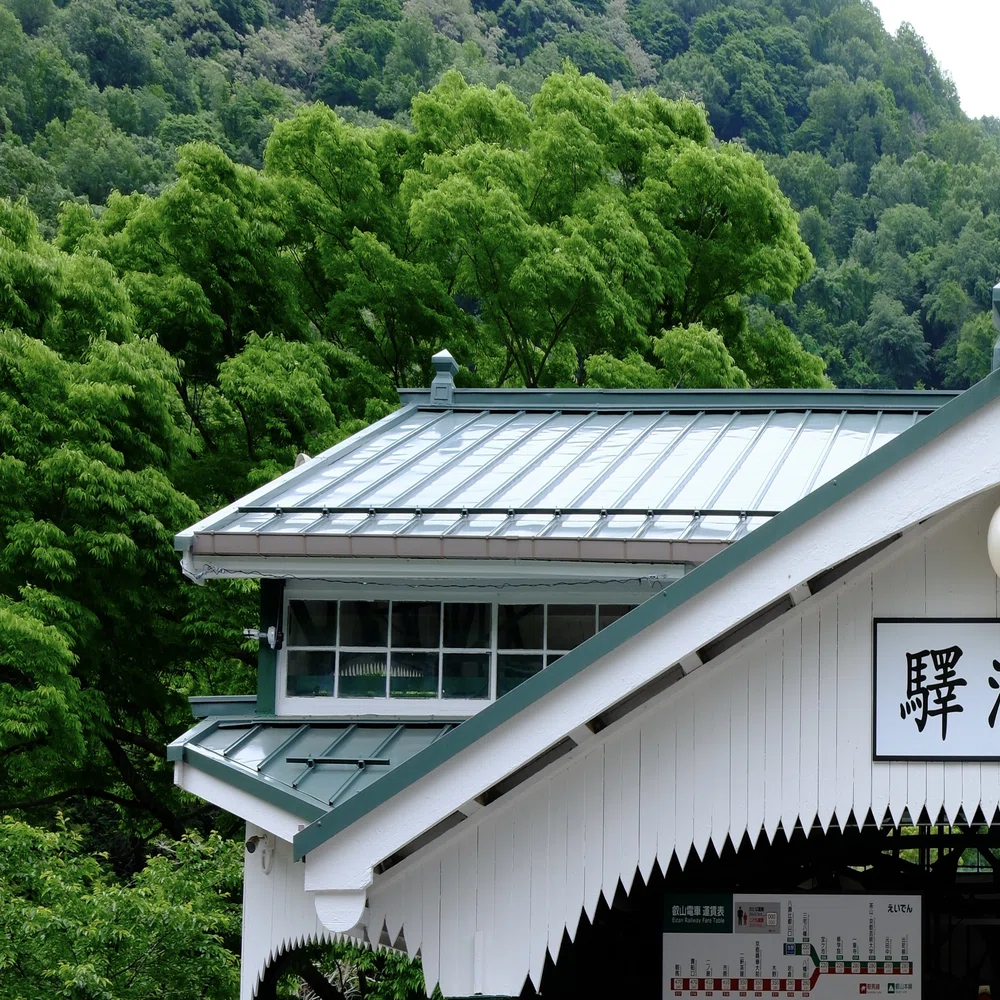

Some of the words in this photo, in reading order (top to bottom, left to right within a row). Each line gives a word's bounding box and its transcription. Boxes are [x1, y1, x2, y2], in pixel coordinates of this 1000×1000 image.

[672, 905, 701, 916] 叡山電車
[702, 905, 724, 916] 運賃表
[888, 904, 912, 913] えいでん
